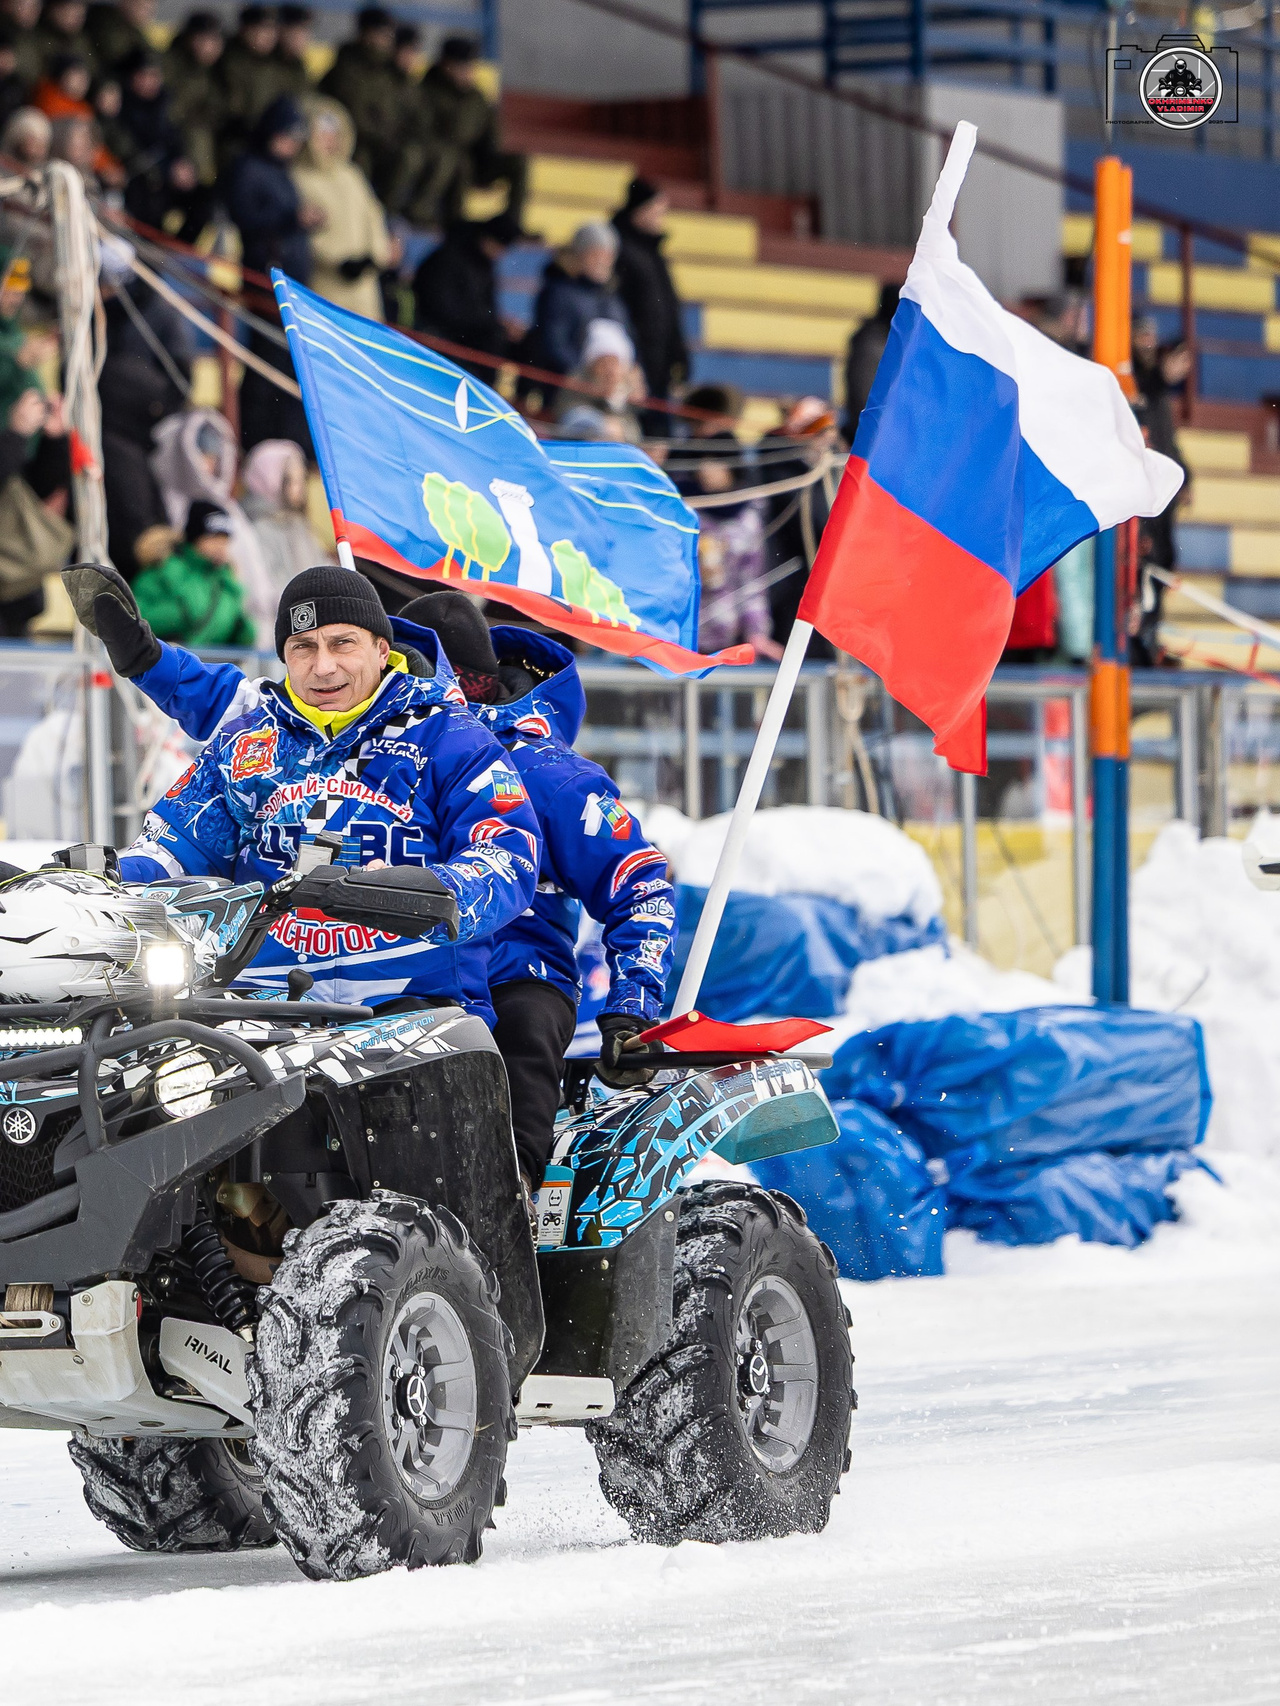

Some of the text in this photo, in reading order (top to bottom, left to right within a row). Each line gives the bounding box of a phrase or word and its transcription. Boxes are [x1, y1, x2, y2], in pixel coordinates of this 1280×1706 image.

[354, 1015, 435, 1052] LIMITED EDITION
[713, 1060, 804, 1094] POWER STEERING
[184, 1334, 233, 1375] RIVAL
